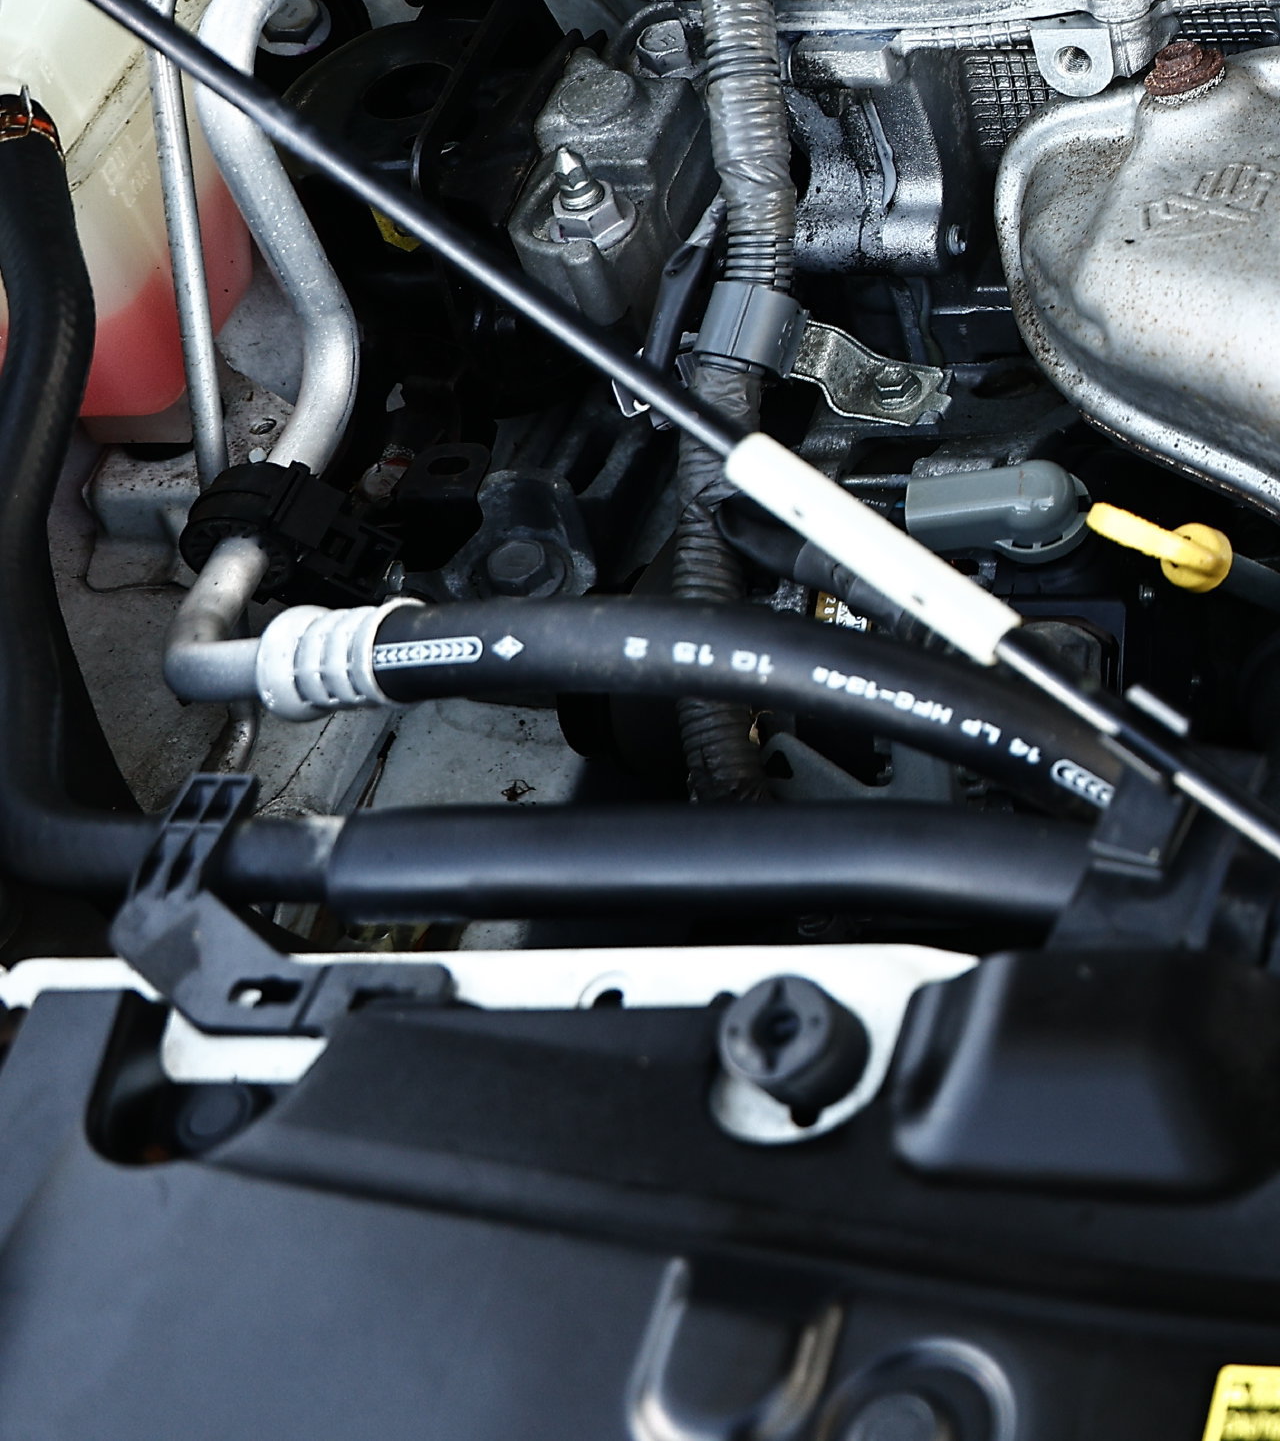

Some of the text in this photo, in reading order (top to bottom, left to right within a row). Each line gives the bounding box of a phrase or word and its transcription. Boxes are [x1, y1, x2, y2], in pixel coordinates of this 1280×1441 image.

[623, 636, 649, 660] 2
[960, 718, 1002, 745] LP
[1008, 737, 1041, 764] 14
